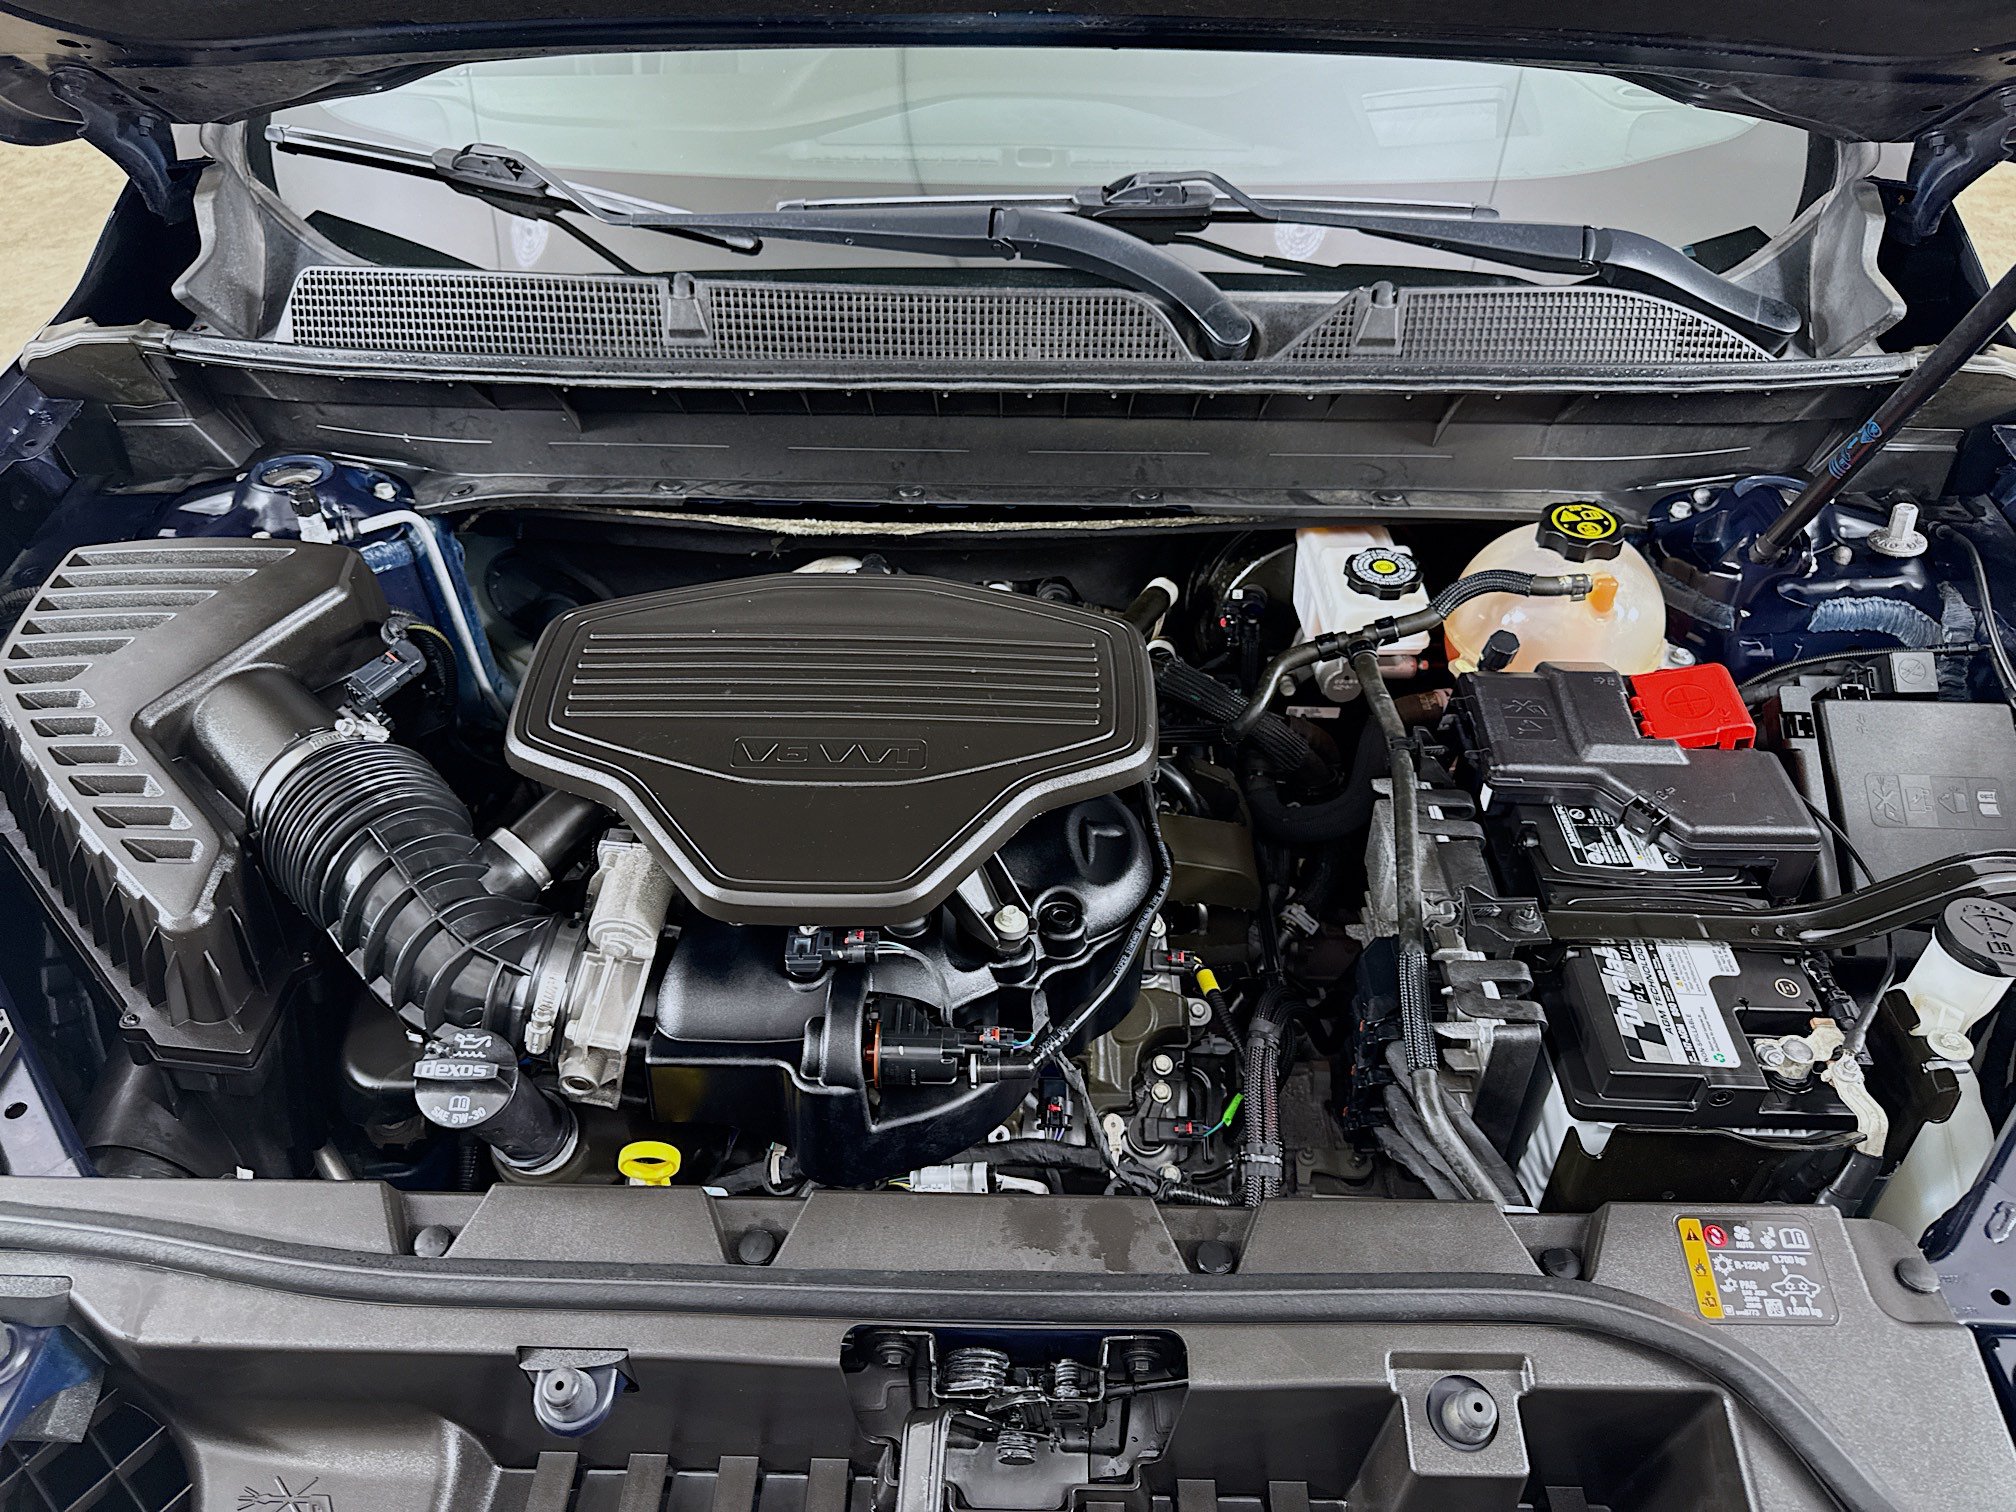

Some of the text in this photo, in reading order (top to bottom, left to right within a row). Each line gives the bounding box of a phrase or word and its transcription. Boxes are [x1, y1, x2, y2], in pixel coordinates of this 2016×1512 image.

[741, 743, 920, 764] V6 VVT
[1599, 945, 1645, 1029] Duralas
[1658, 1009, 1674, 1036] AGM
[421, 1060, 490, 1077] dexos
[431, 1106, 487, 1124] SAE 5W-30
